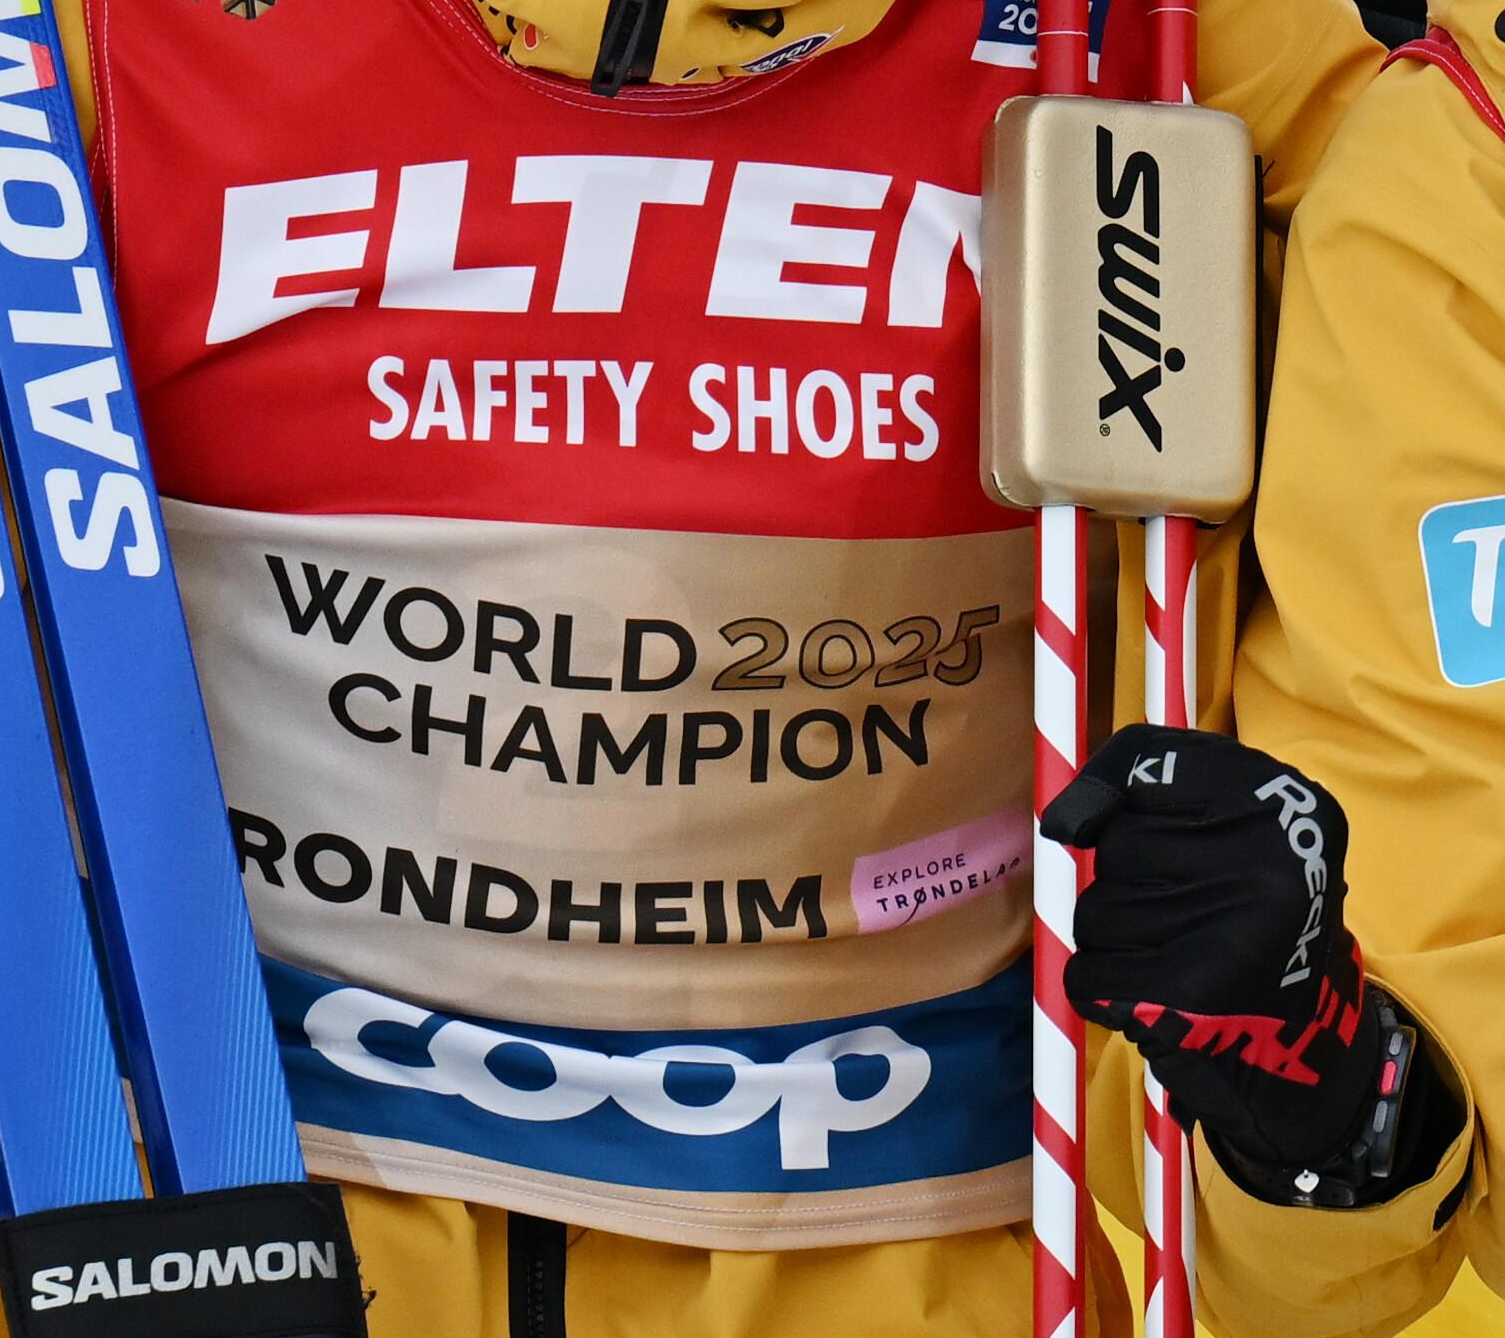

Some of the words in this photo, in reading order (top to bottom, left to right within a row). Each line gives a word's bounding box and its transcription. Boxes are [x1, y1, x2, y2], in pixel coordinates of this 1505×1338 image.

[1096, 124, 1187, 453] swix
[366, 355, 655, 449] SAFETY
[692, 361, 942, 463] SHOES
[265, 555, 697, 694] WORLD
[712, 604, 1001, 692] 2025
[327, 671, 931, 786] CHAMPION
[873, 852, 968, 890] EXPLORE
[303, 986, 933, 1171] coop
[30, 1239, 338, 1312] SALOMON
